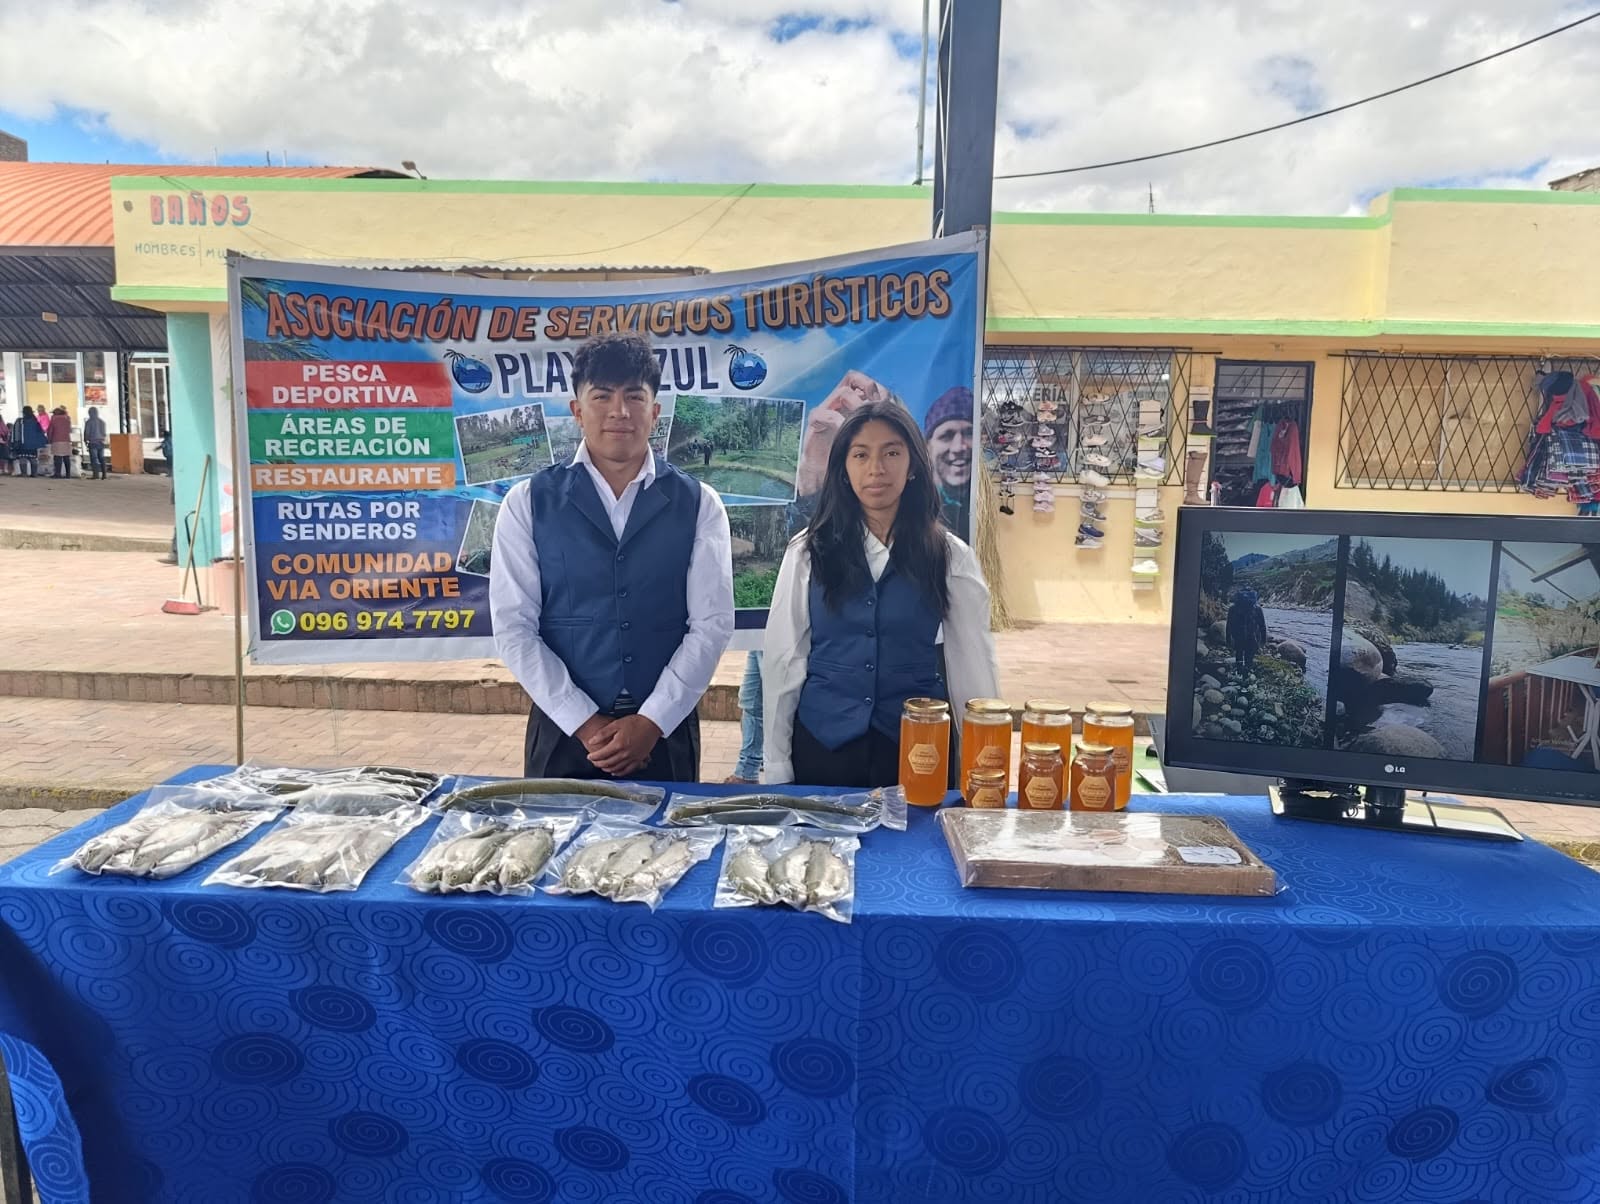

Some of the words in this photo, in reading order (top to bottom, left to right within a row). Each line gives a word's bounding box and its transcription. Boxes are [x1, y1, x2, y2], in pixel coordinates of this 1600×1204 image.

[150, 190, 251, 226] BAÑOS
[134, 242, 196, 257] HOMBRES
[266, 291, 481, 342] ASOCIACIÓN
[487, 304, 541, 342] DE
[543, 293, 735, 342] SERVICIOS
[741, 268, 952, 332] TURÍSTICOS
[302, 364, 387, 383] PESCA
[494, 350, 578, 394] PLA
[650, 346, 719, 393] ZUL
[272, 386, 419, 405] DEPORTIVA
[280, 413, 366, 435] ÁREAS
[374, 416, 407, 435] DE
[264, 434, 431, 457] RECREACIÓN
[255, 467, 442, 487] RESTAURANTE
[278, 501, 362, 521] RUTAS
[370, 501, 420, 520] POR
[282, 523, 418, 542] SENDEROS
[271, 552, 453, 576] COMUNIDAD
[266, 579, 321, 601] VIA
[329, 576, 461, 600] ORIENTE
[299, 612, 349, 632] 096
[356, 611, 405, 632] 974
[412, 609, 477, 631] 7797
